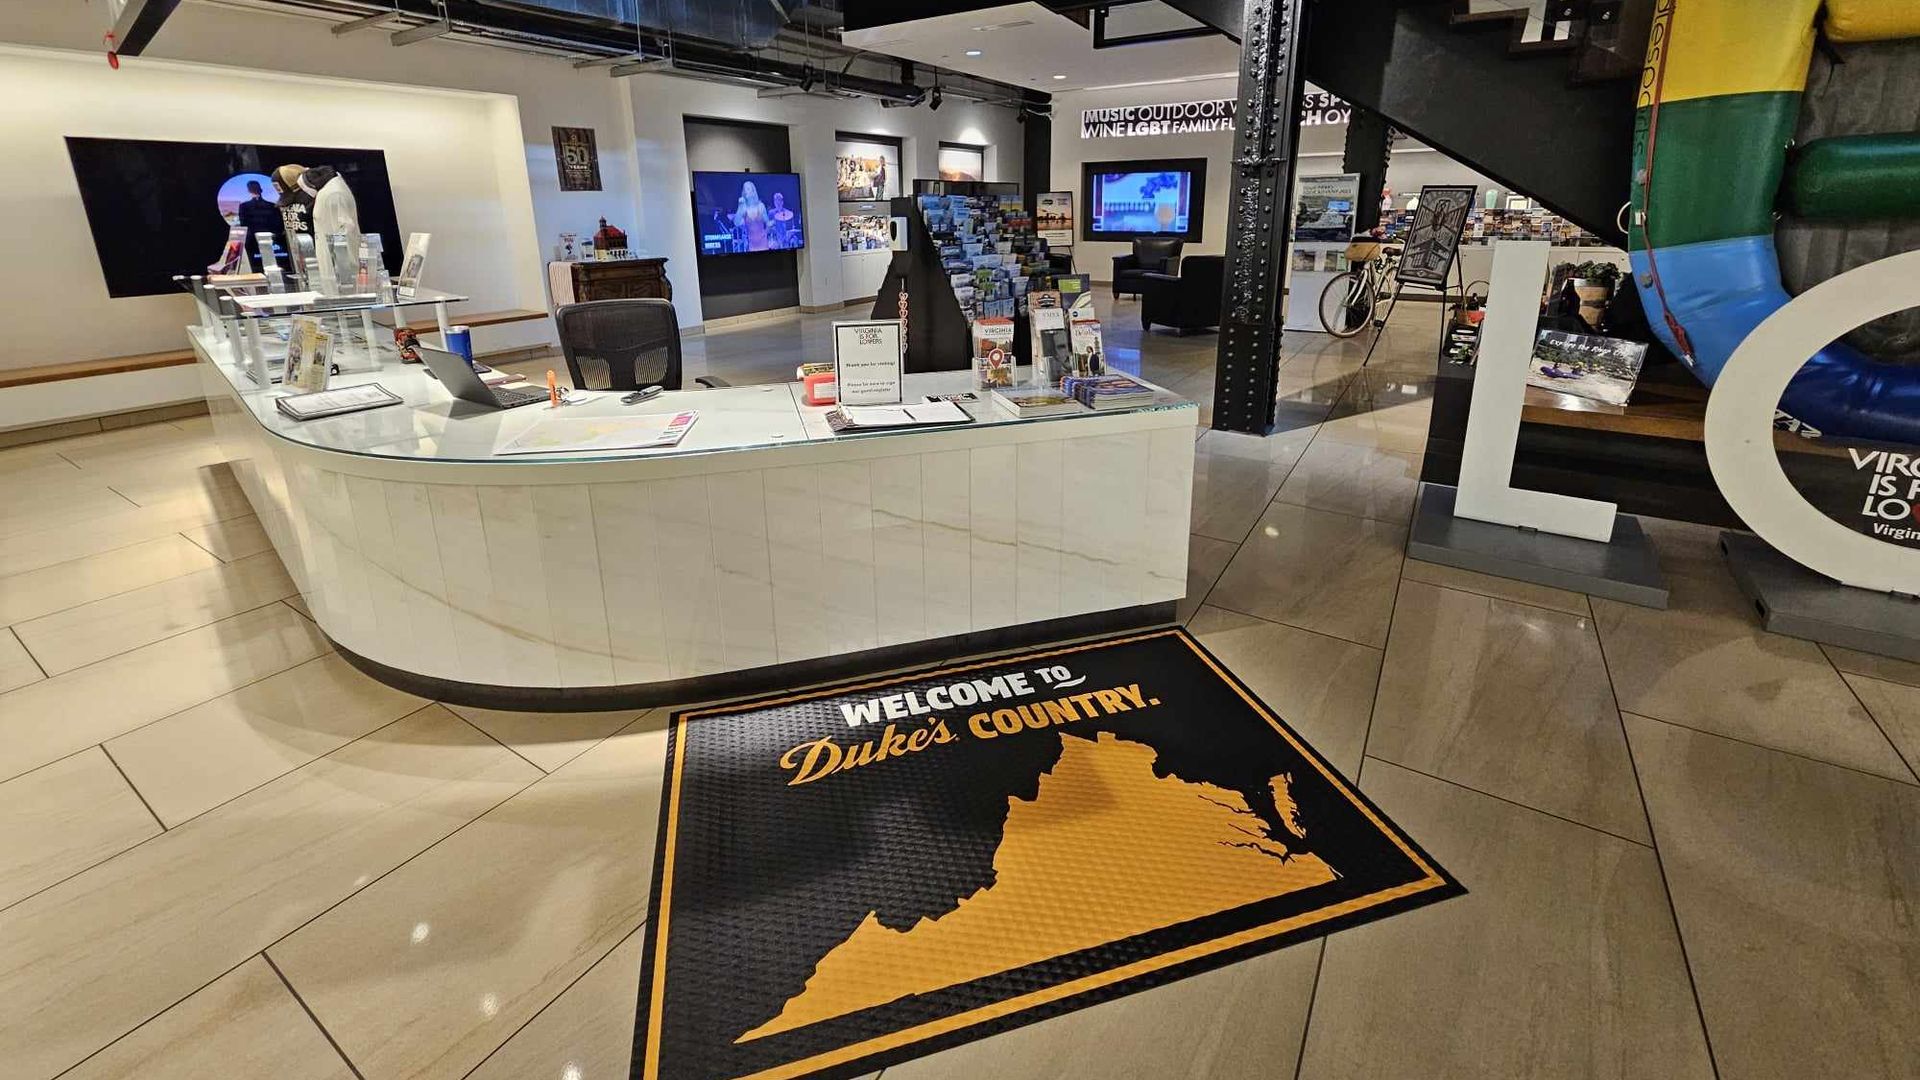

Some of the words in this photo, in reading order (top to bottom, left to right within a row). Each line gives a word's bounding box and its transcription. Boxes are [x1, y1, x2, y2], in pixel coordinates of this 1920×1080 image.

[1084, 109, 1135, 123] MUSIC
[1137, 101, 1226, 121] OUTDOOR
[1084, 121, 1125, 138] WINE
[1126, 120, 1171, 136] LGBT
[1172, 118, 1220, 134] FAMILY
[1868, 473, 1897, 496] IS
[839, 672, 1036, 728] WELCOME
[1034, 664, 1076, 688] TO
[780, 716, 958, 787] Duke's
[967, 683, 1162, 740] COUNTRY.
